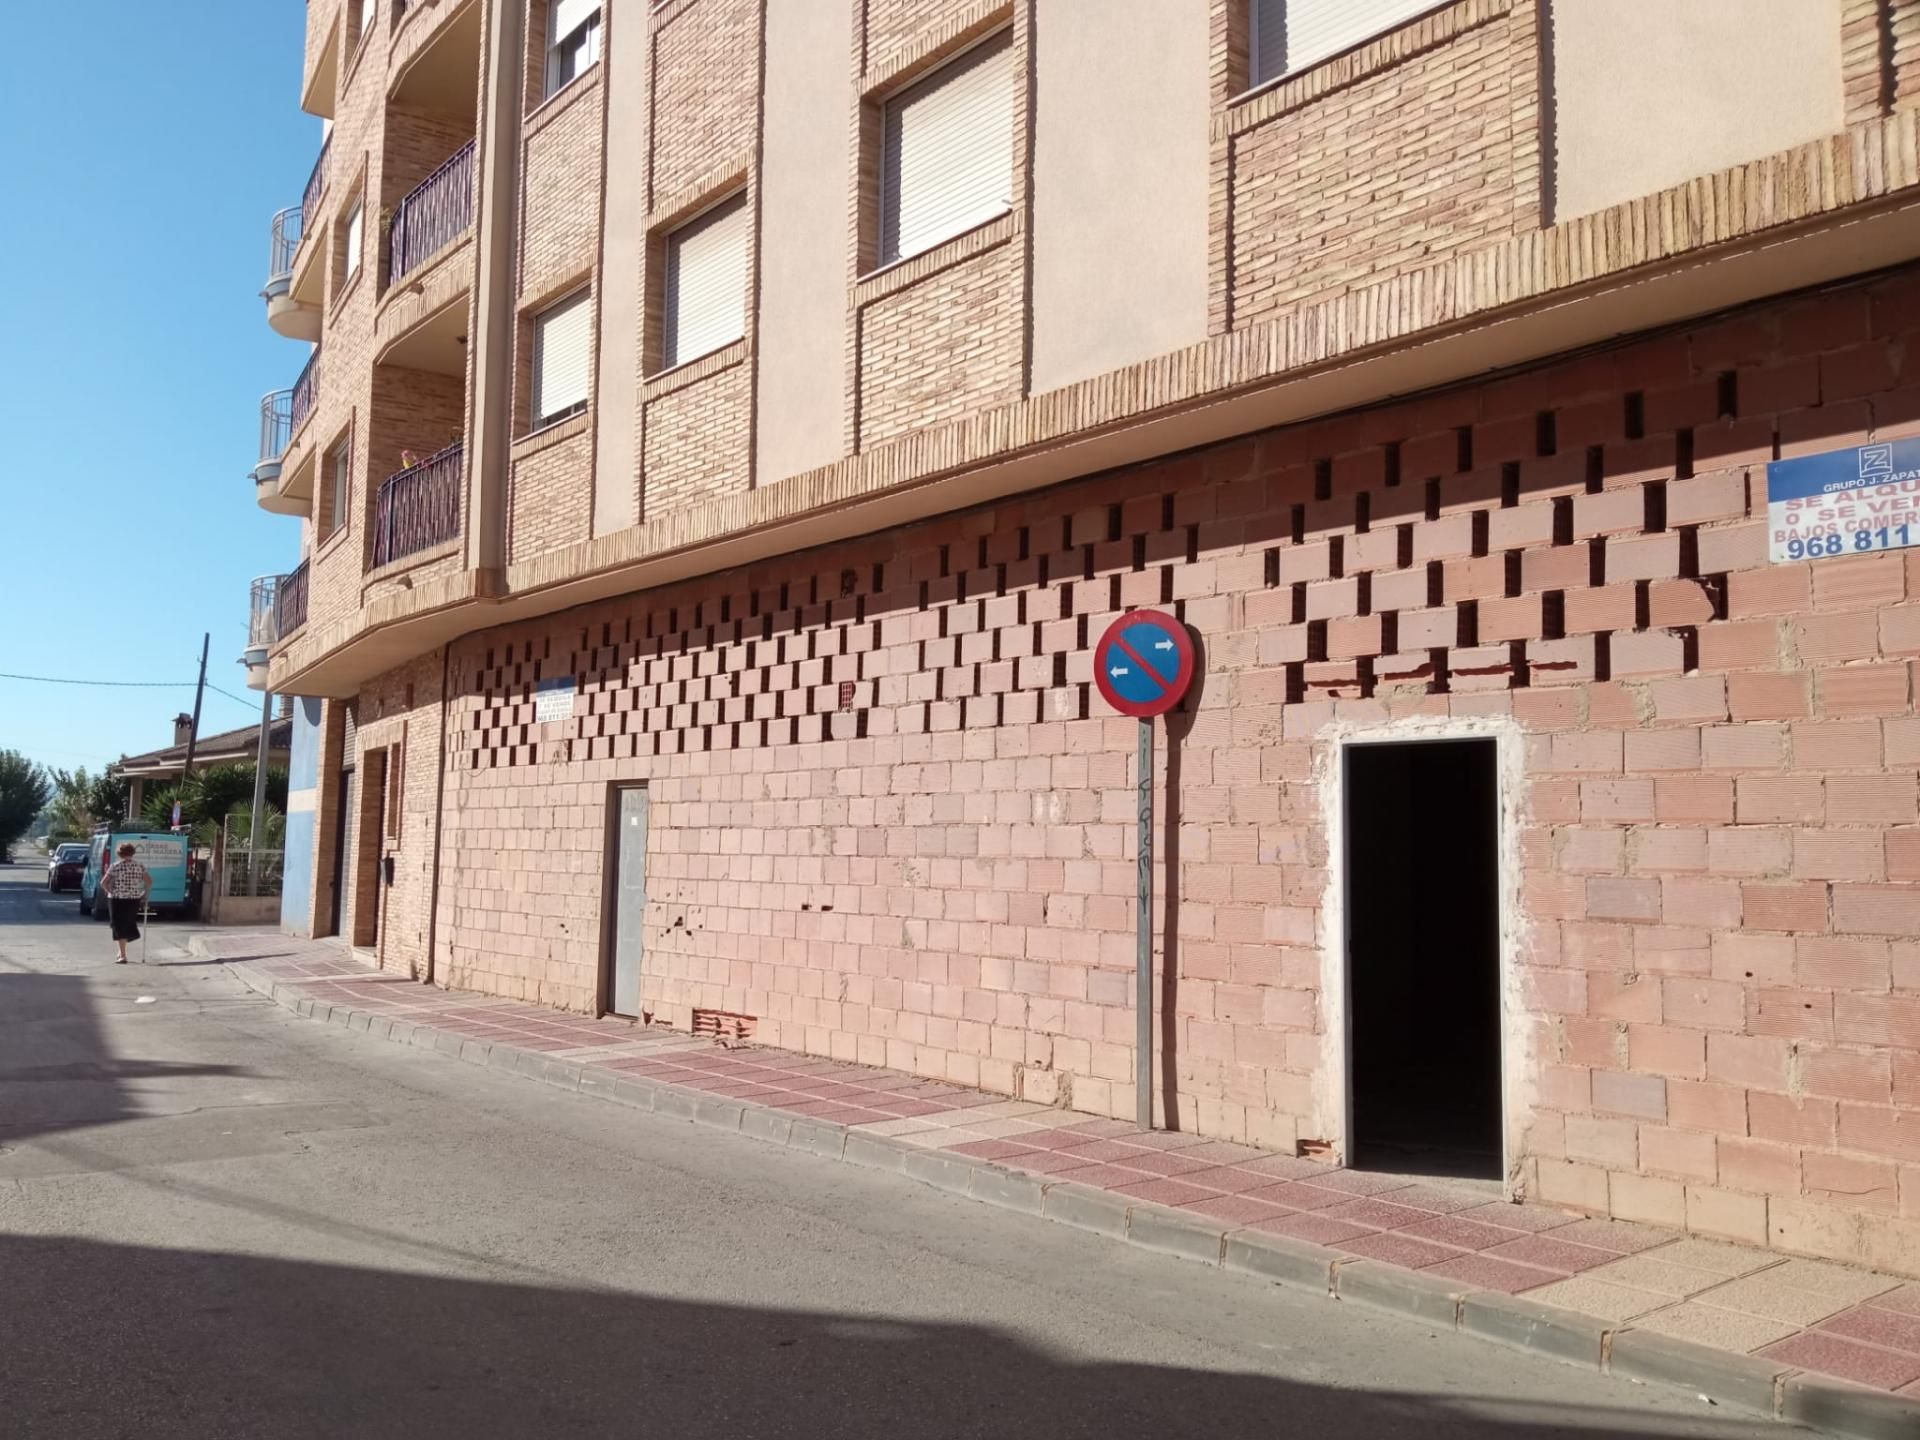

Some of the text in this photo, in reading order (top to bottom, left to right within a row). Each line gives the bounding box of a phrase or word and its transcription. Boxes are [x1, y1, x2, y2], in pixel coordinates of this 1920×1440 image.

[1823, 479, 1865, 492] GRUPO
[1869, 476, 1880, 487] J.
[1785, 495, 1823, 511] SE
[1785, 513, 1800, 525] O
[1818, 505, 1856, 521] SE
[1774, 511, 1920, 543] BAJOS COMER
[1787, 523, 1909, 560] 968 811
